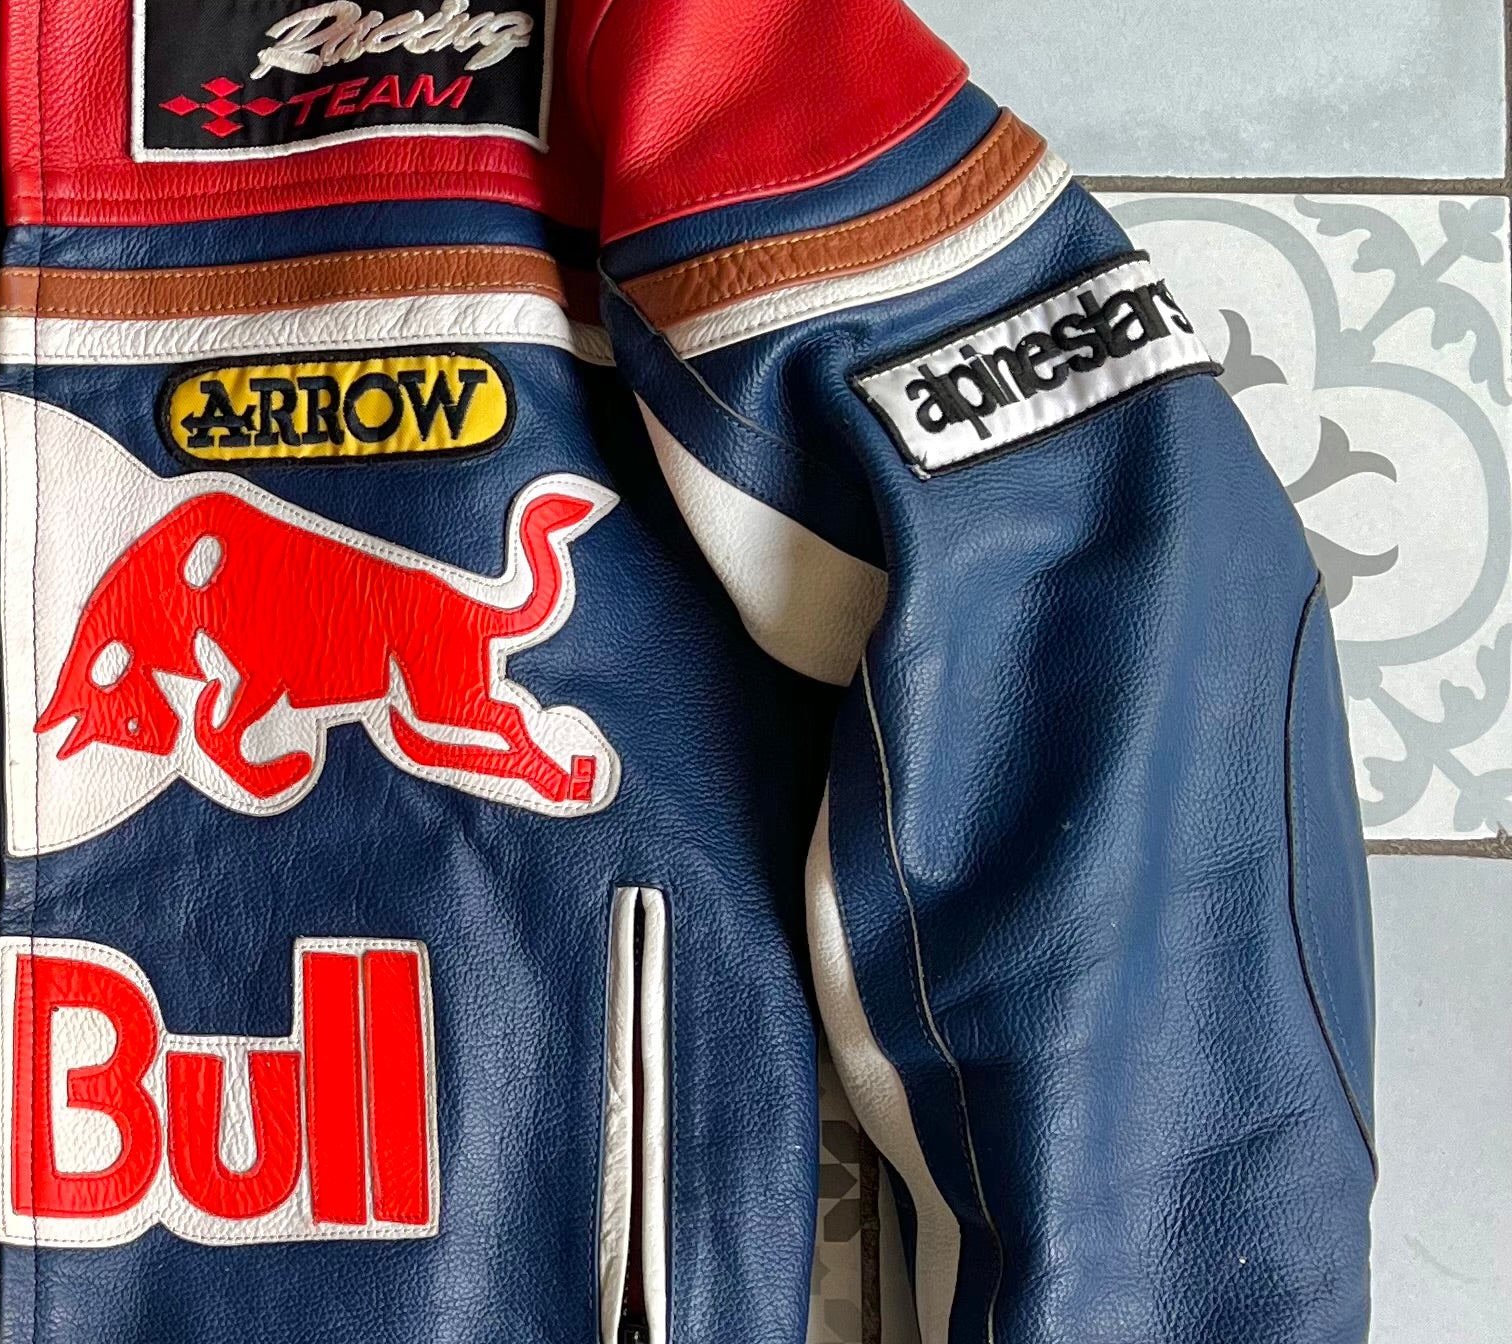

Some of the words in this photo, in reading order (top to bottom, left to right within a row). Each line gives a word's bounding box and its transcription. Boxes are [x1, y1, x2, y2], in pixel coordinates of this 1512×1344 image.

[288, 74, 474, 127] TEAM
[180, 369, 488, 448] ARROW
[12, 950, 430, 1226] Bull
